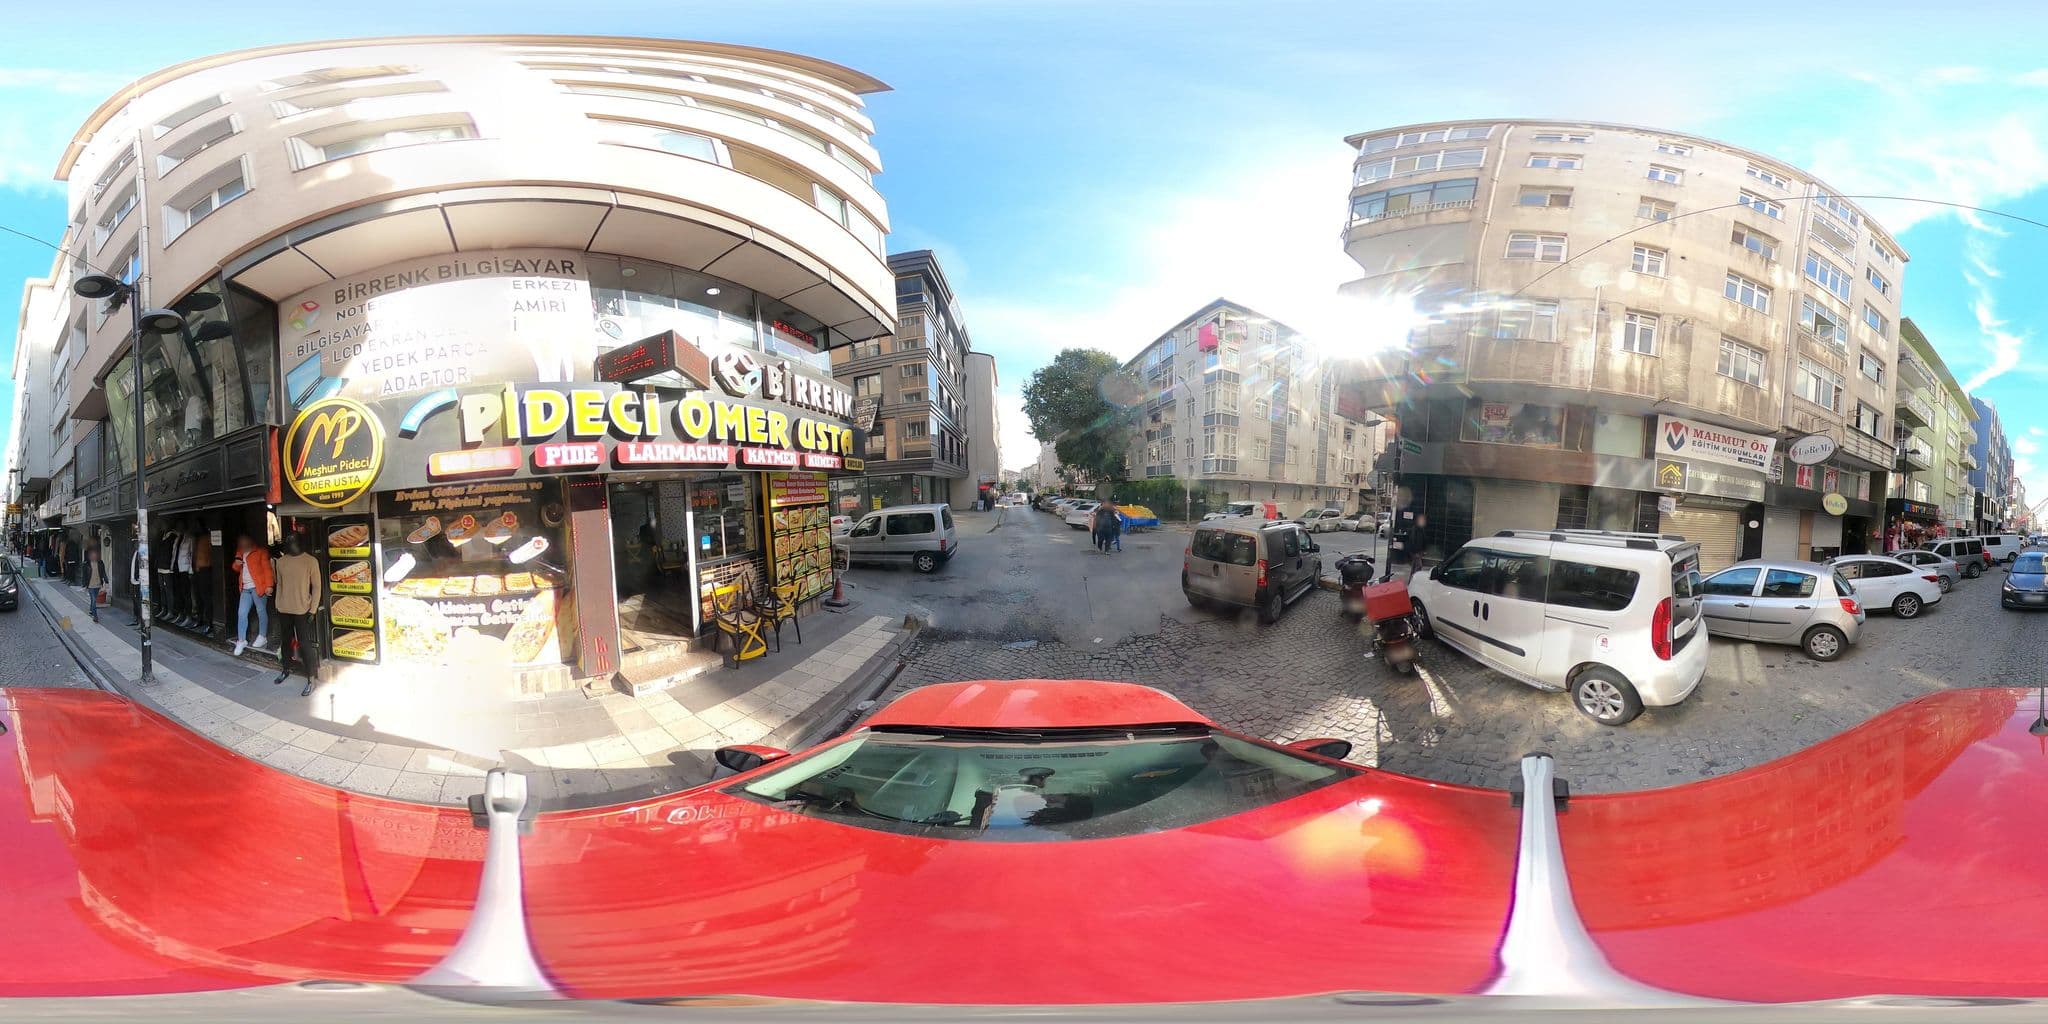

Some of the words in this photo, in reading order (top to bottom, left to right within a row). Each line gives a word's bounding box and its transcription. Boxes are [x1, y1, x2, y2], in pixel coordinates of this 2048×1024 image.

[334, 267, 431, 305] BİRRENK
[438, 257, 576, 279] BİLGİSAYAR
[333, 343, 363, 363] LCD
[361, 352, 420, 374] YEDEK
[766, 360, 853, 418] BİRRENK
[678, 391, 789, 450] ÖMER
[797, 412, 855, 457] USTA
[1692, 439, 1720, 451] EĞİTİM
[1722, 446, 1766, 461] KURUMLARI
[1693, 428, 1747, 448] MAHMUT
[1750, 439, 1769, 453] ÖN
[545, 443, 599, 466] PİDE
[629, 443, 729, 463] LAHMACUN
[747, 447, 798, 466] KATMER
[303, 463, 338, 477] Meşhur
[340, 456, 370, 471] Pideci
[334, 475, 361, 487] USTA
